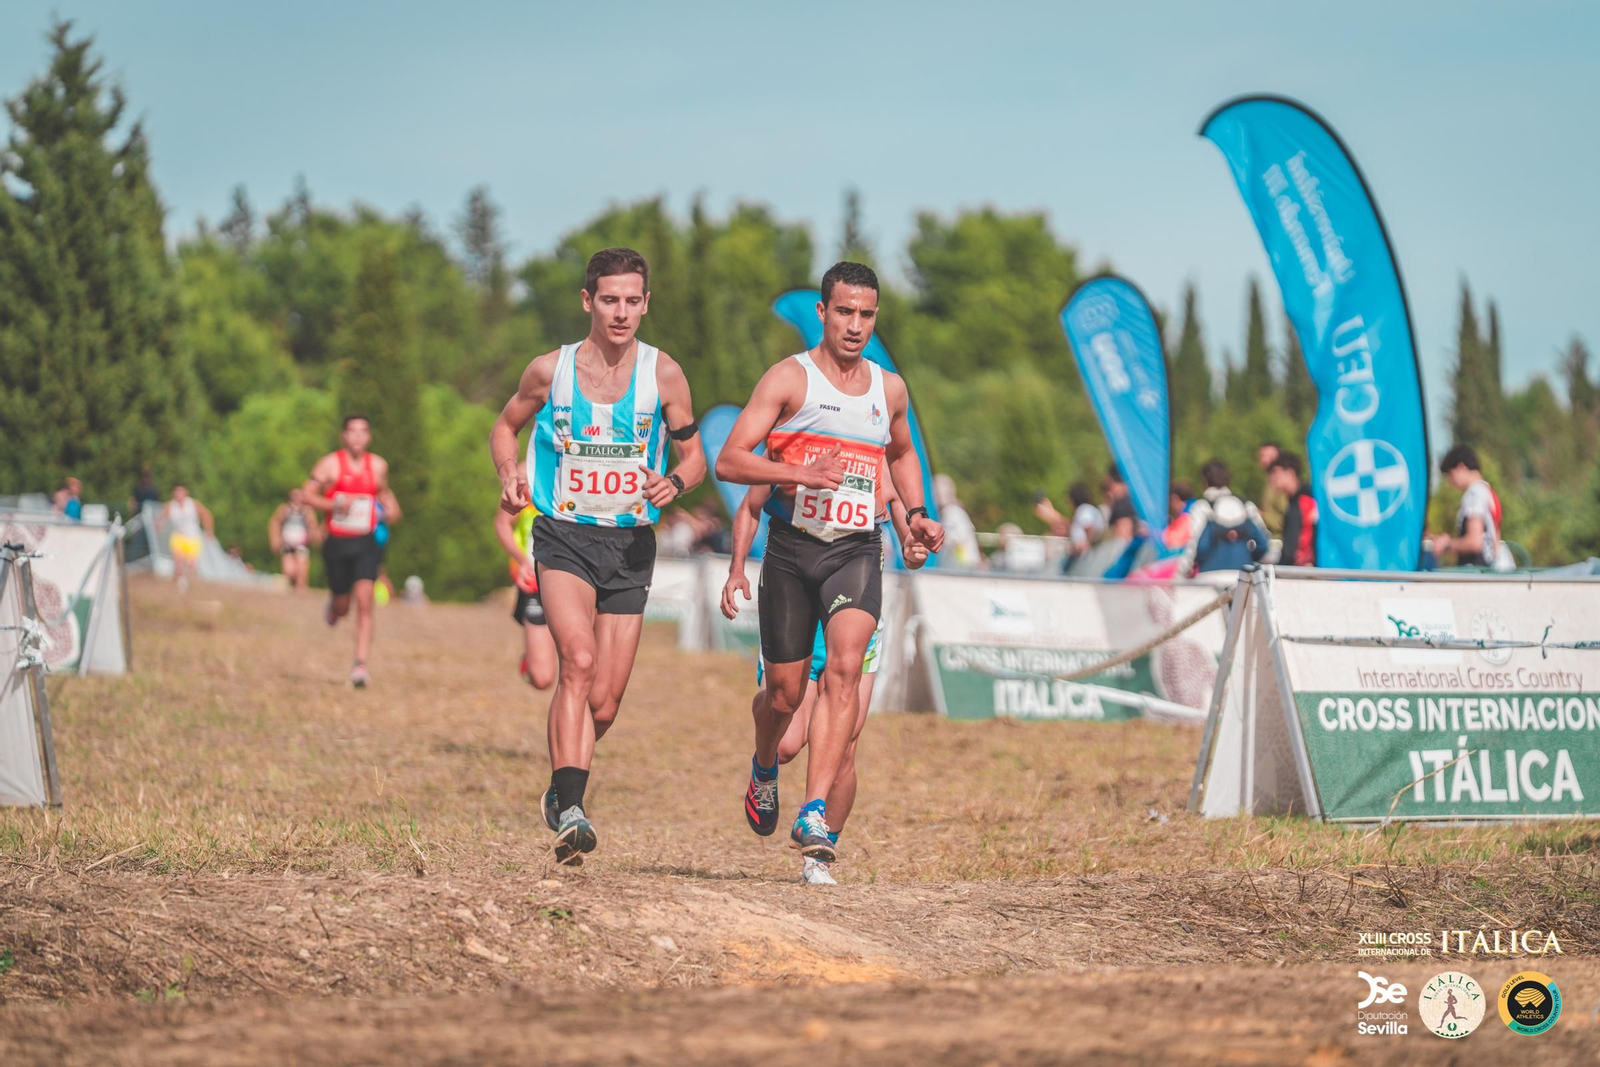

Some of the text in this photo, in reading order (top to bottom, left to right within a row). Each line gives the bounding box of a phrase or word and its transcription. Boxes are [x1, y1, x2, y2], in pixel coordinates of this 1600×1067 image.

[819, 403, 841, 412] FASTER
[805, 445, 821, 453] CLUB
[569, 468, 639, 495] 5103
[801, 494, 868, 527] 5105
[1357, 666, 1583, 694] International Cross Country
[1318, 697, 1413, 731] CROSS
[1409, 735, 1584, 803] ITÁLICA
